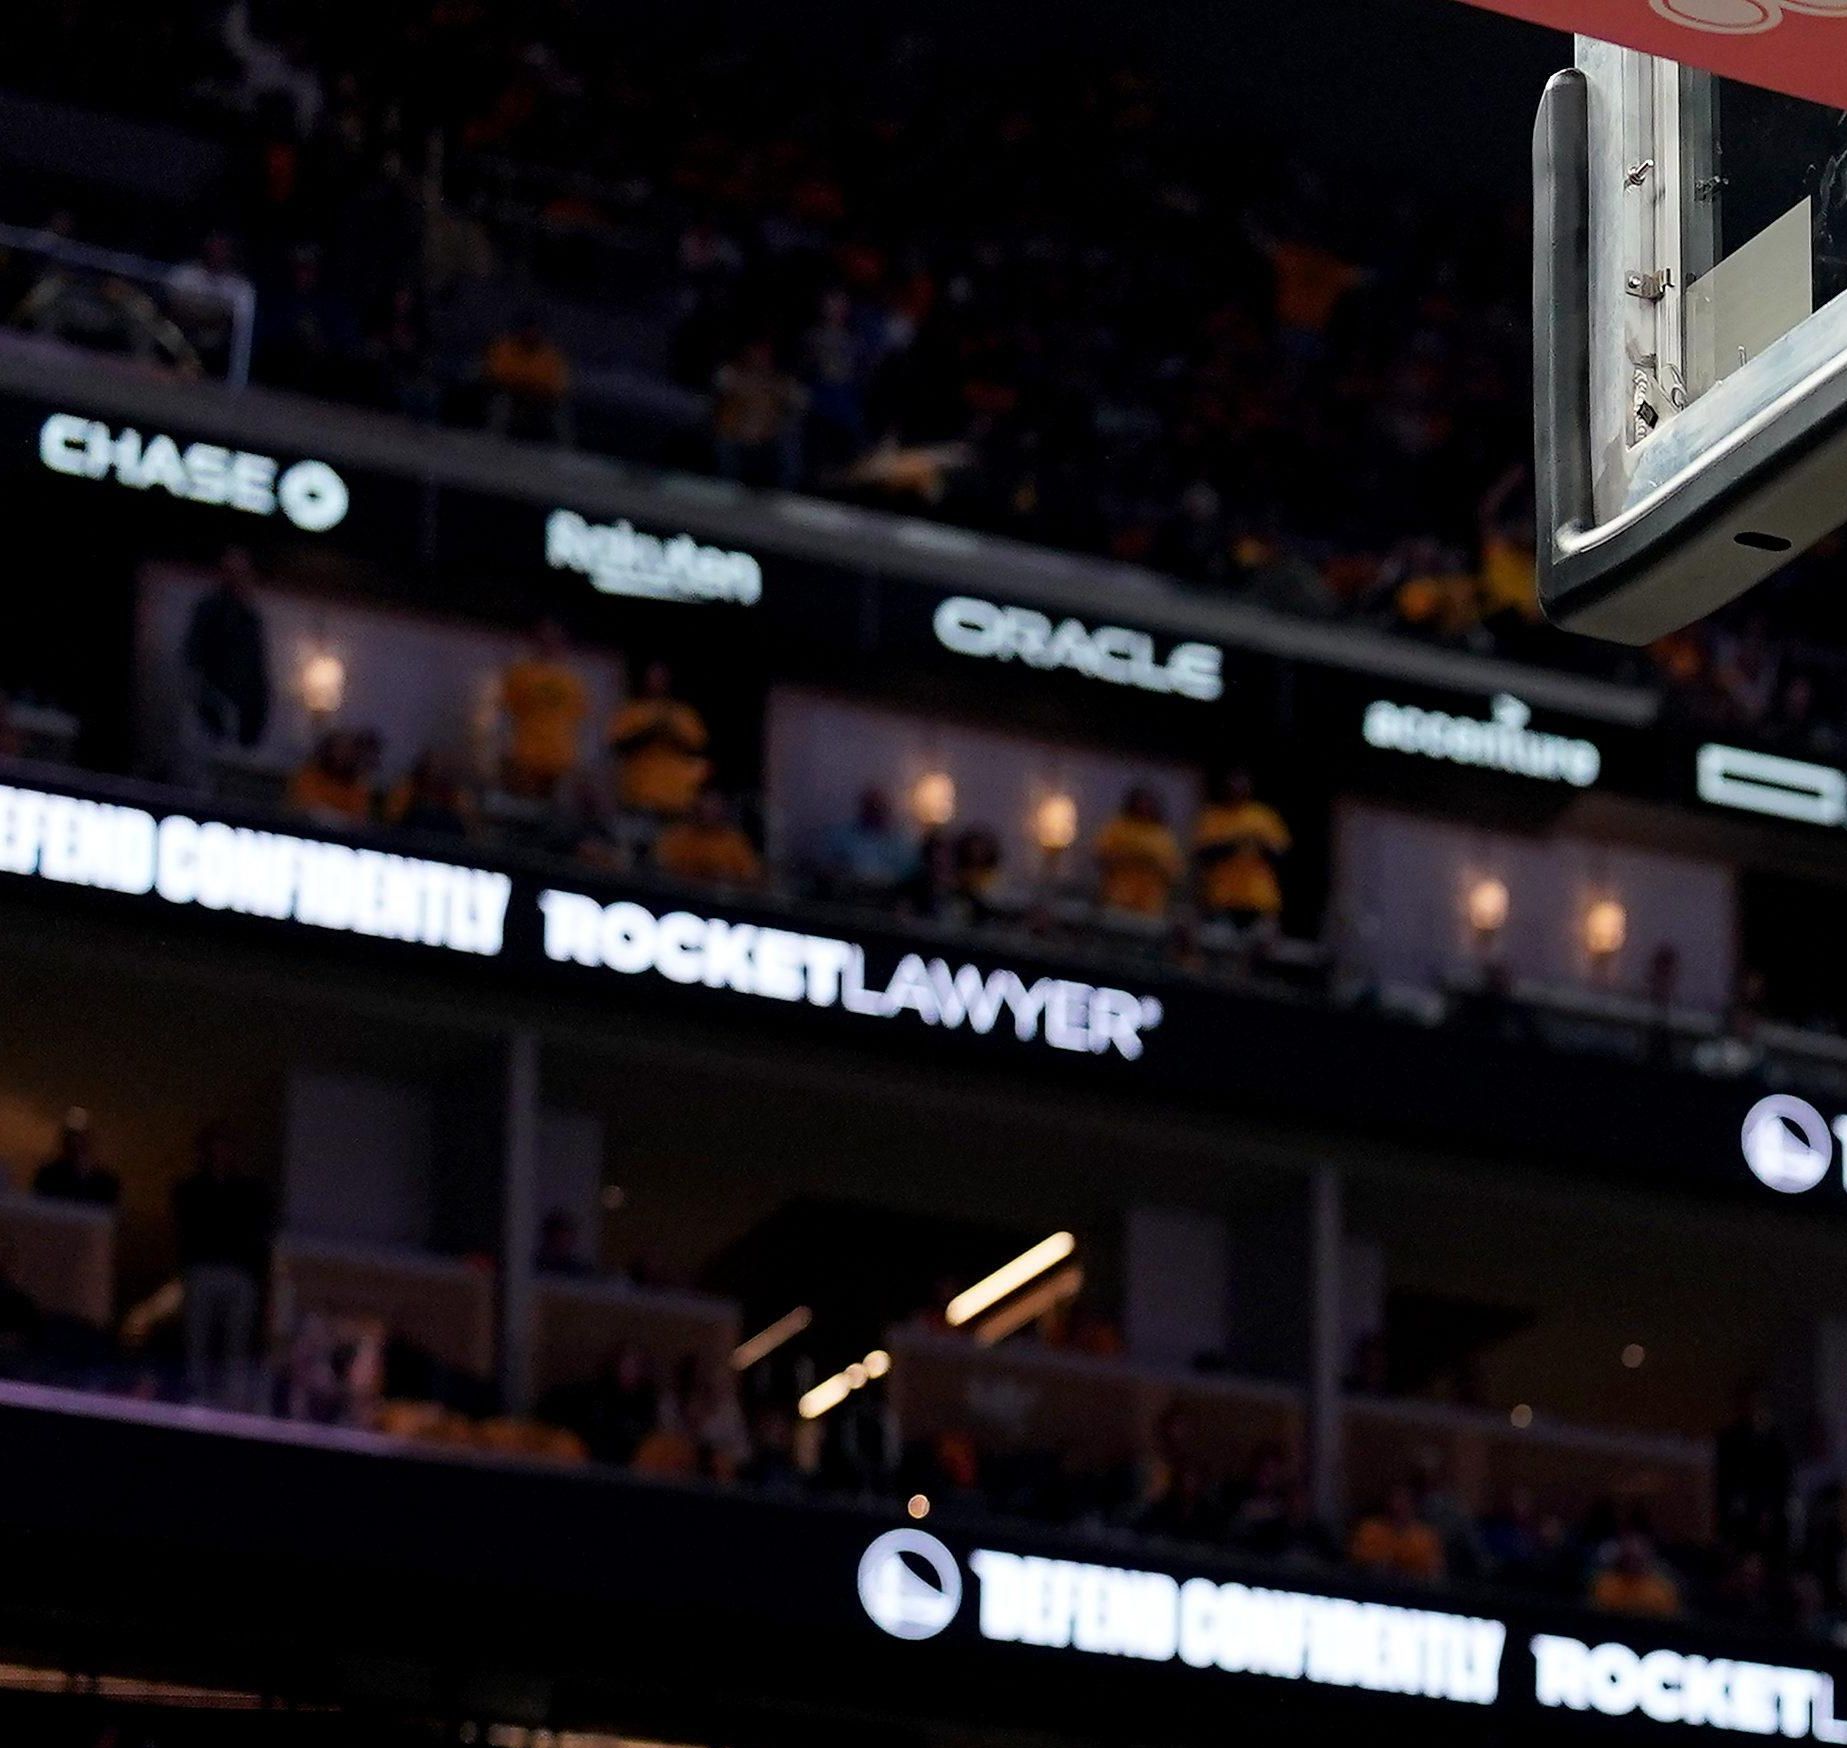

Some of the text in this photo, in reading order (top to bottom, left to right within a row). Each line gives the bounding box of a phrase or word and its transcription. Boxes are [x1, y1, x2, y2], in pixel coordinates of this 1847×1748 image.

[40, 413, 276, 515] CHASE
[546, 510, 762, 605] Rakuten
[934, 596, 1222, 700] ORACLE
